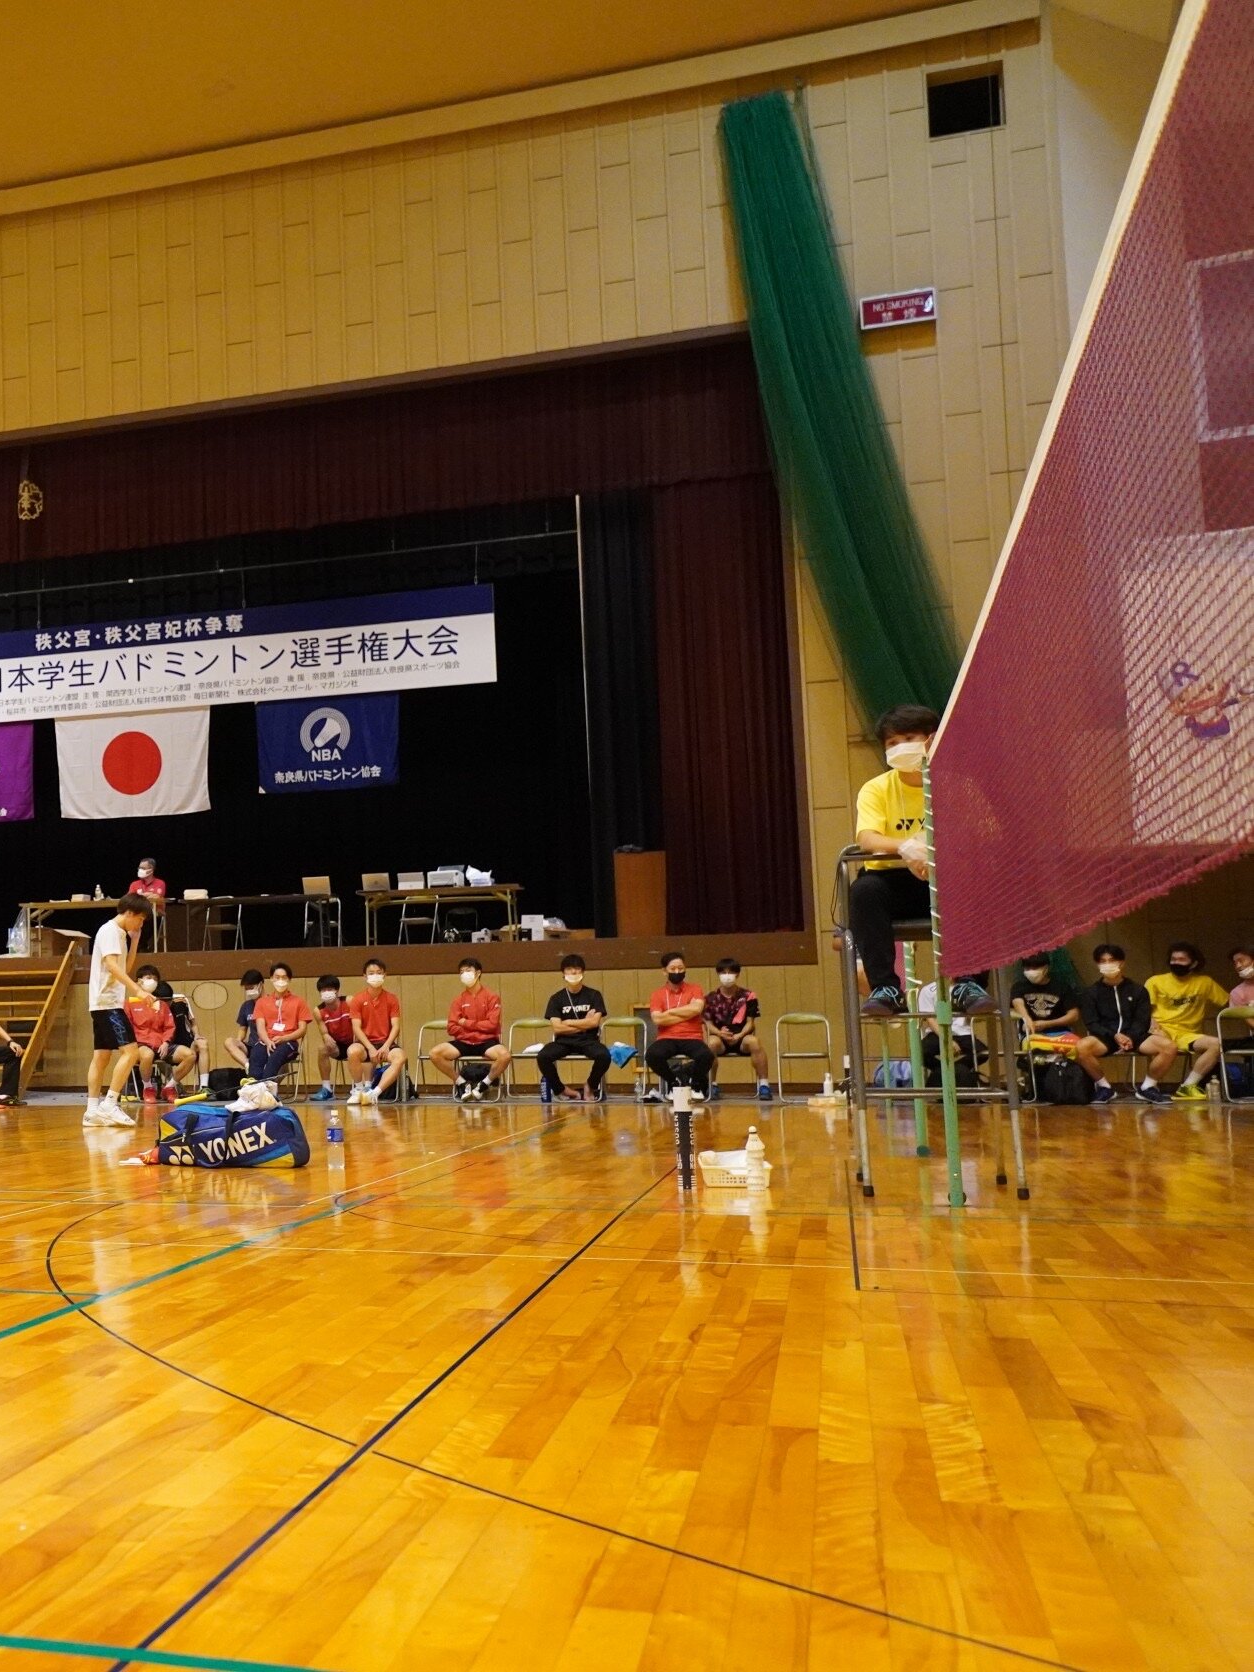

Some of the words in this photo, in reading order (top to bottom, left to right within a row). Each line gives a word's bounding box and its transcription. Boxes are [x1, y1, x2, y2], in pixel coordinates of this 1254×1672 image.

[311, 748, 341, 762] NBA
[274, 764, 382, 784] 奈良県バドミントン協会
[198, 1121, 275, 1164] YONEX
